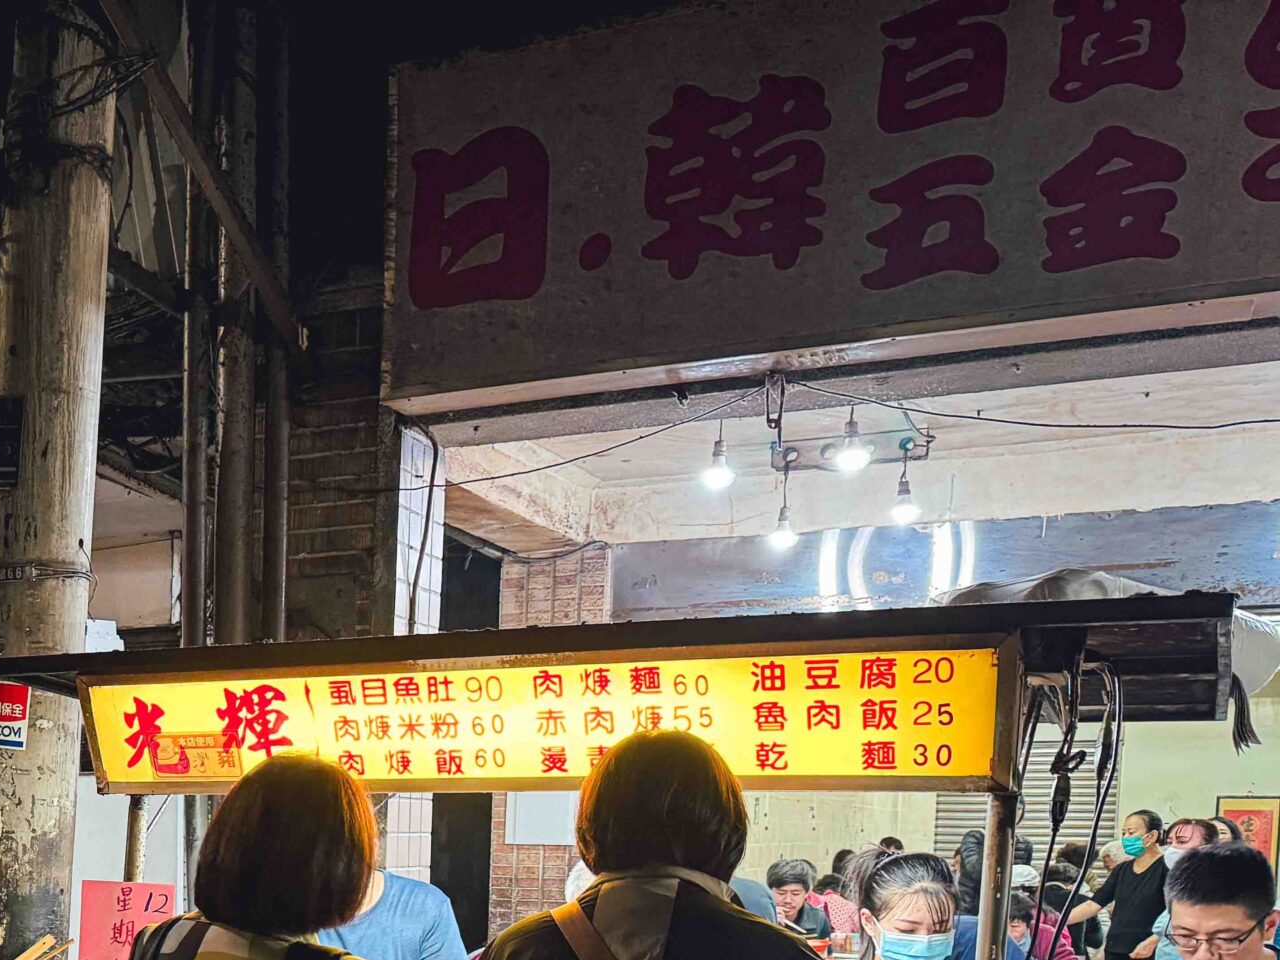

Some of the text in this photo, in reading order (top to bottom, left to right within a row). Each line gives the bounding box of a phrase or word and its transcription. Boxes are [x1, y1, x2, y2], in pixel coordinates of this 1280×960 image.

[673, 674, 709, 696] 60
[750, 657, 955, 692] 油豆腐 20
[465, 675, 503, 703] 90
[124, 684, 294, 768] 光輝
[472, 714, 504, 736] 60
[673, 705, 713, 732] 55
[752, 699, 954, 731] 魯肉飯 25
[475, 748, 506, 768] 60
[913, 744, 953, 767] 30
